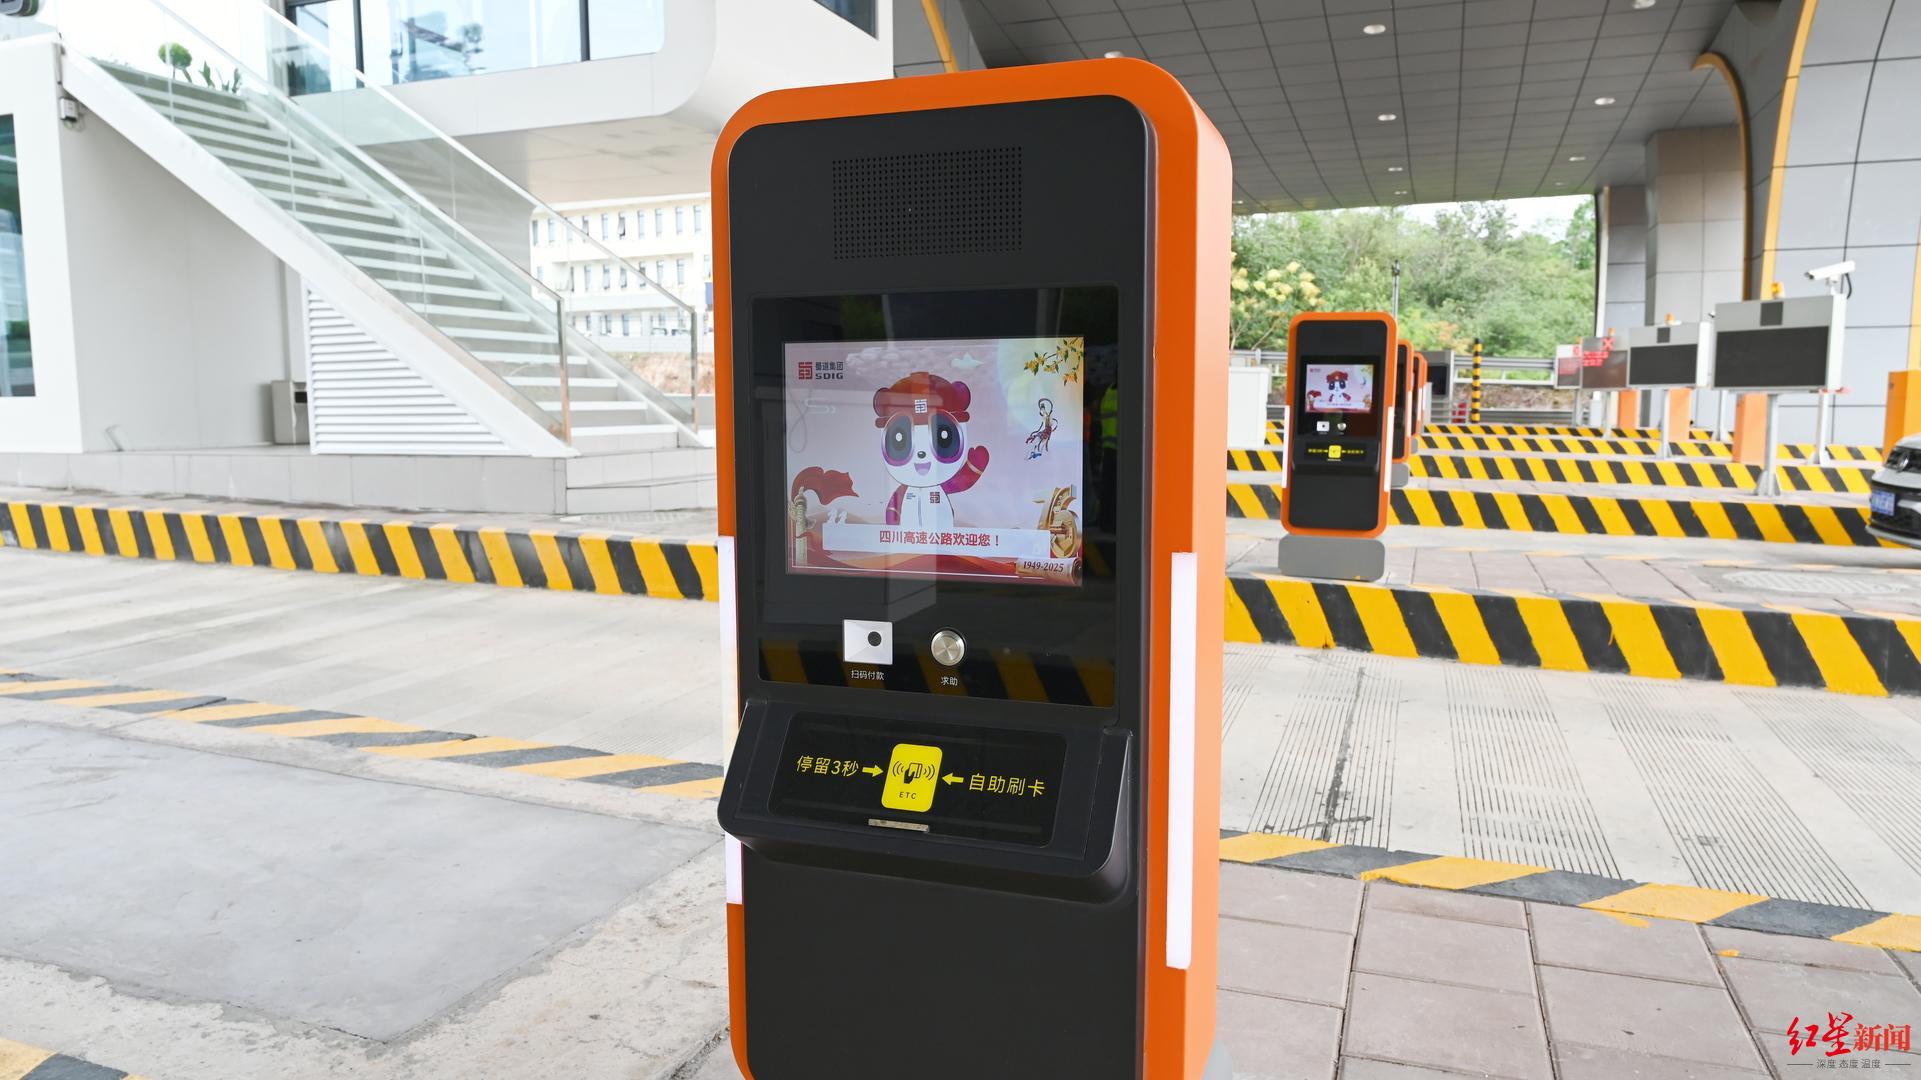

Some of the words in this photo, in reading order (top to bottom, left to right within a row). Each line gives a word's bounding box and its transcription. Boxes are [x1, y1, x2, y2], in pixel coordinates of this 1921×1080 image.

[815, 372, 844, 380] SDIG
[1023, 561, 1065, 573] 1949-2025
[851, 669, 885, 681] 扫码付款
[940, 676, 958, 686] 求助
[796, 755, 859, 777] 停留3秒
[969, 773, 1045, 797] 自助刷卡
[898, 791, 917, 800] ETC
